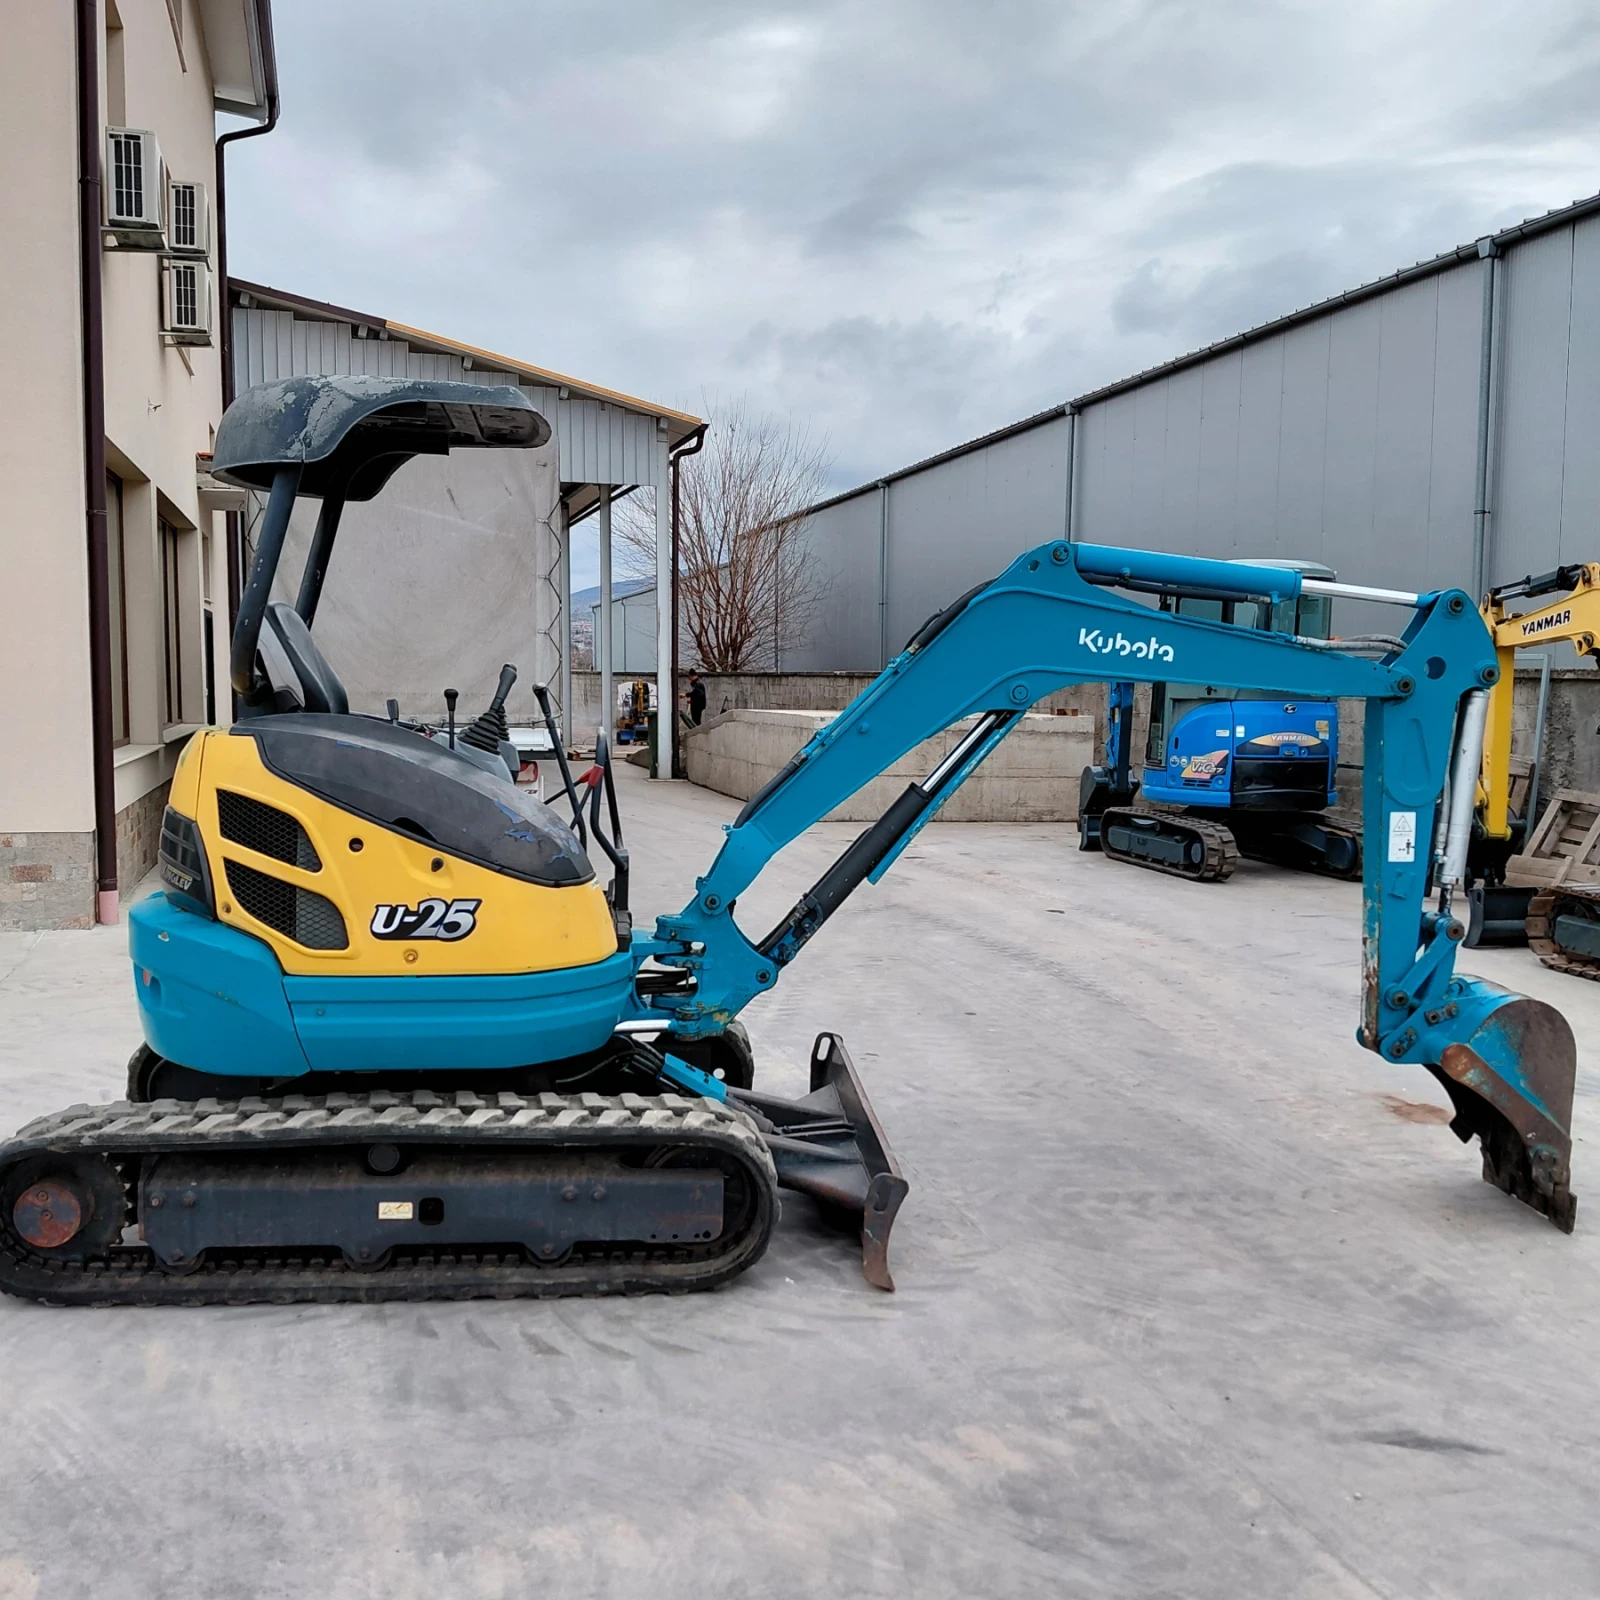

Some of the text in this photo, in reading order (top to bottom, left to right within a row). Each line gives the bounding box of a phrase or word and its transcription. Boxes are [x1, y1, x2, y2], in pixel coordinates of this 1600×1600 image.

[1522, 610, 1571, 636] YANMAR
[1079, 628, 1175, 662] Kubota
[371, 899, 480, 939] U-25
